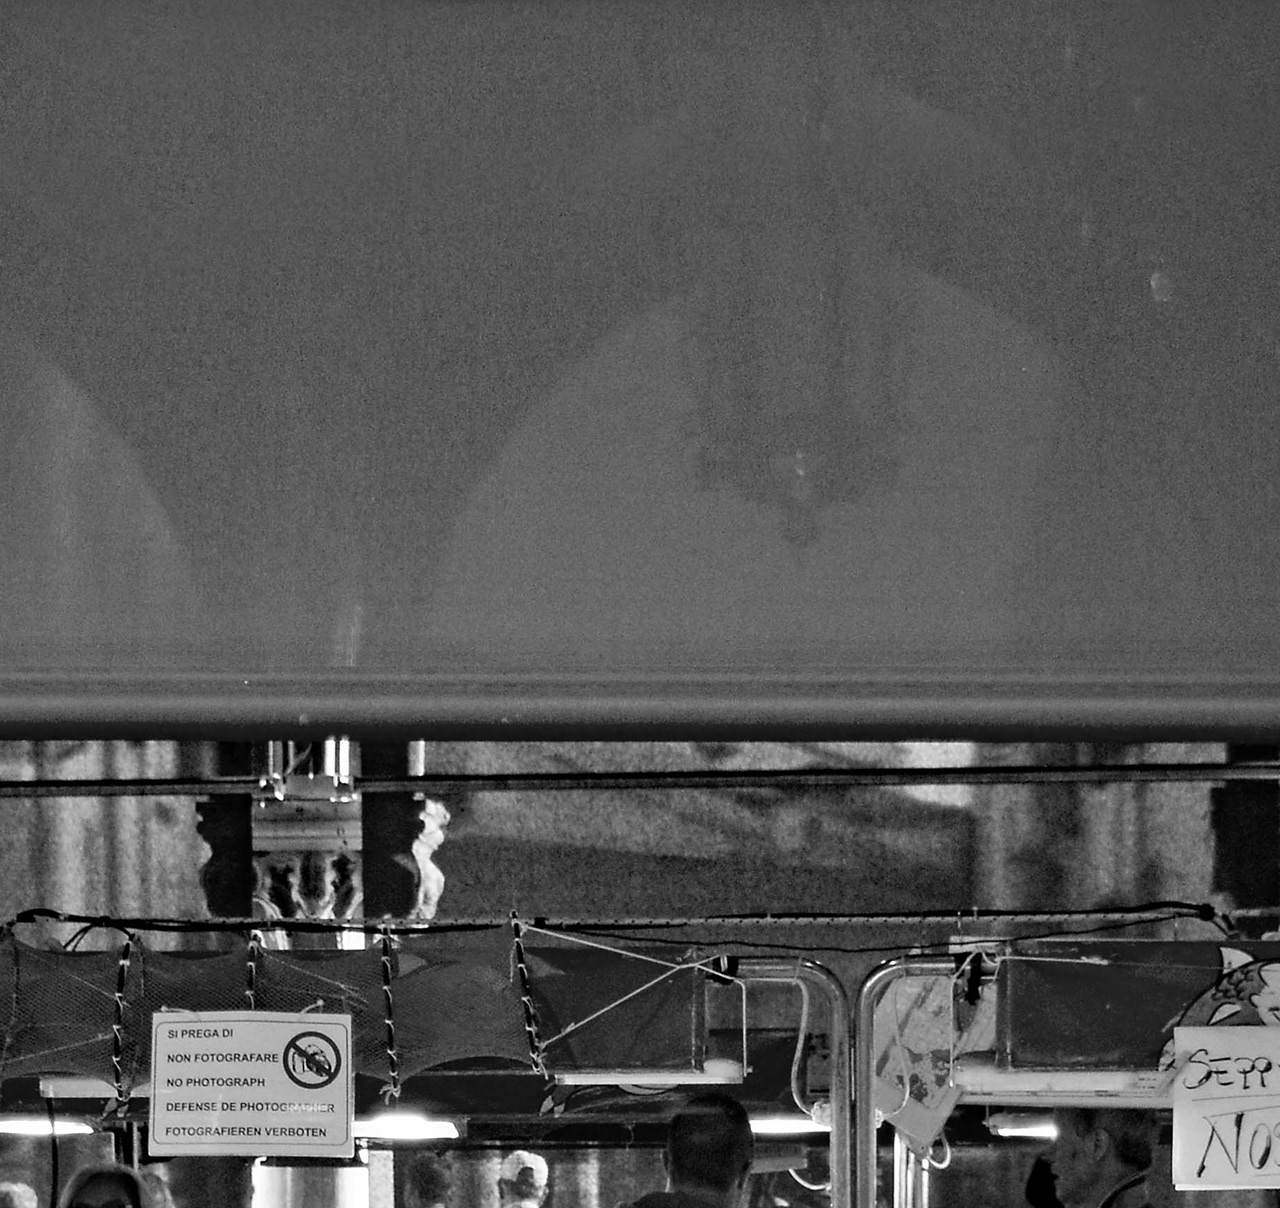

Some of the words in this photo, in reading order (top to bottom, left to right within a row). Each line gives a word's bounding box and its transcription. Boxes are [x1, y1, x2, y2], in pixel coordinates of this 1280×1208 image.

[168, 1029, 178, 1039] SI
[181, 1028, 220, 1039] PREGA
[222, 1028, 234, 1038] DI
[167, 1053, 191, 1063] NON
[194, 1053, 279, 1063] FOTOGRAFARE
[167, 1078, 183, 1087] NO
[186, 1078, 266, 1087] PHOTOGRAPH
[166, 1102, 217, 1112] DEFENSE
[221, 1102, 236, 1112] DE
[239, 1102, 335, 1113] PHOTOGRAPHER
[165, 1127, 262, 1137] FOTOGRAFIEREN
[264, 1127, 327, 1137] VERBOTEN
